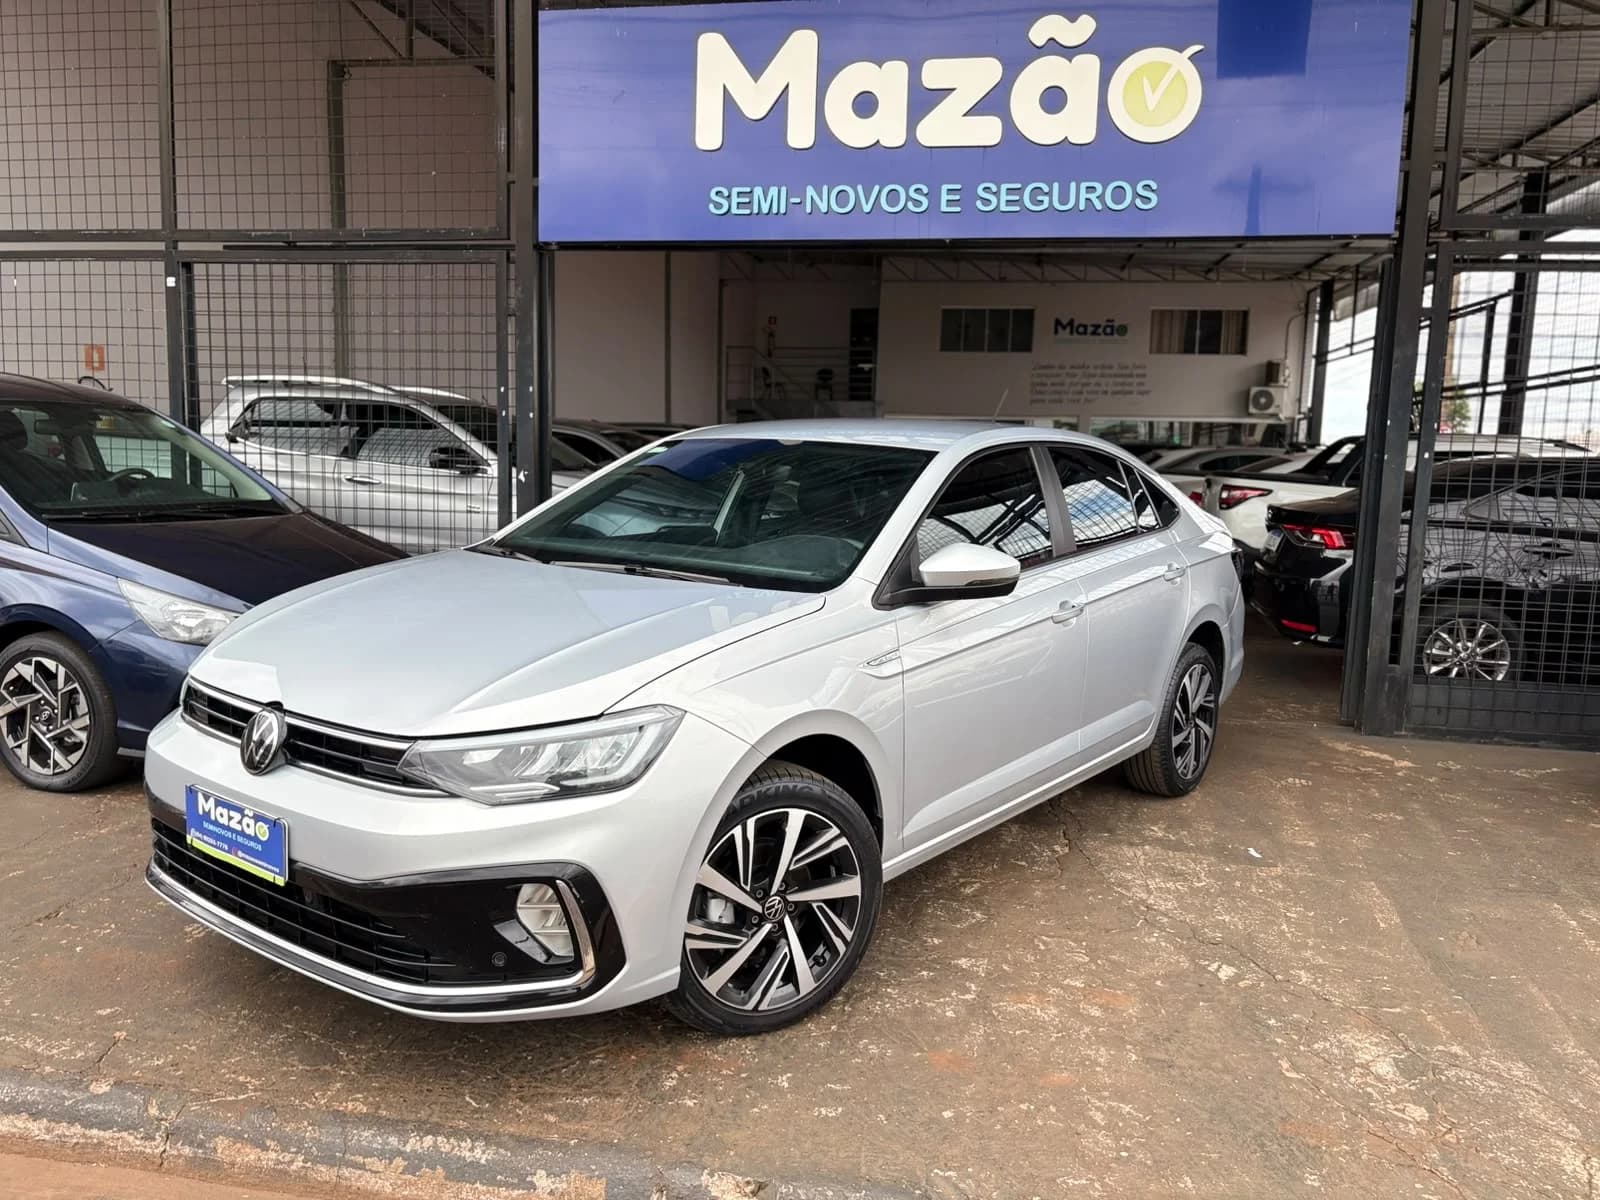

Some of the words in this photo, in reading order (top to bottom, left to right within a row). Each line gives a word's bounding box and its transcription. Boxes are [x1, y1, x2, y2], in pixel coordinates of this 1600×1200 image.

[695, 14, 1204, 151] Mazão
[708, 183, 930, 215] SEMI-NOVOS
[940, 183, 962, 213] E
[975, 180, 1158, 212] SEGUROS
[1053, 317, 1128, 336] Mazão
[197, 791, 270, 842] Mazão
[237, 835, 262, 852] SEGUROS
